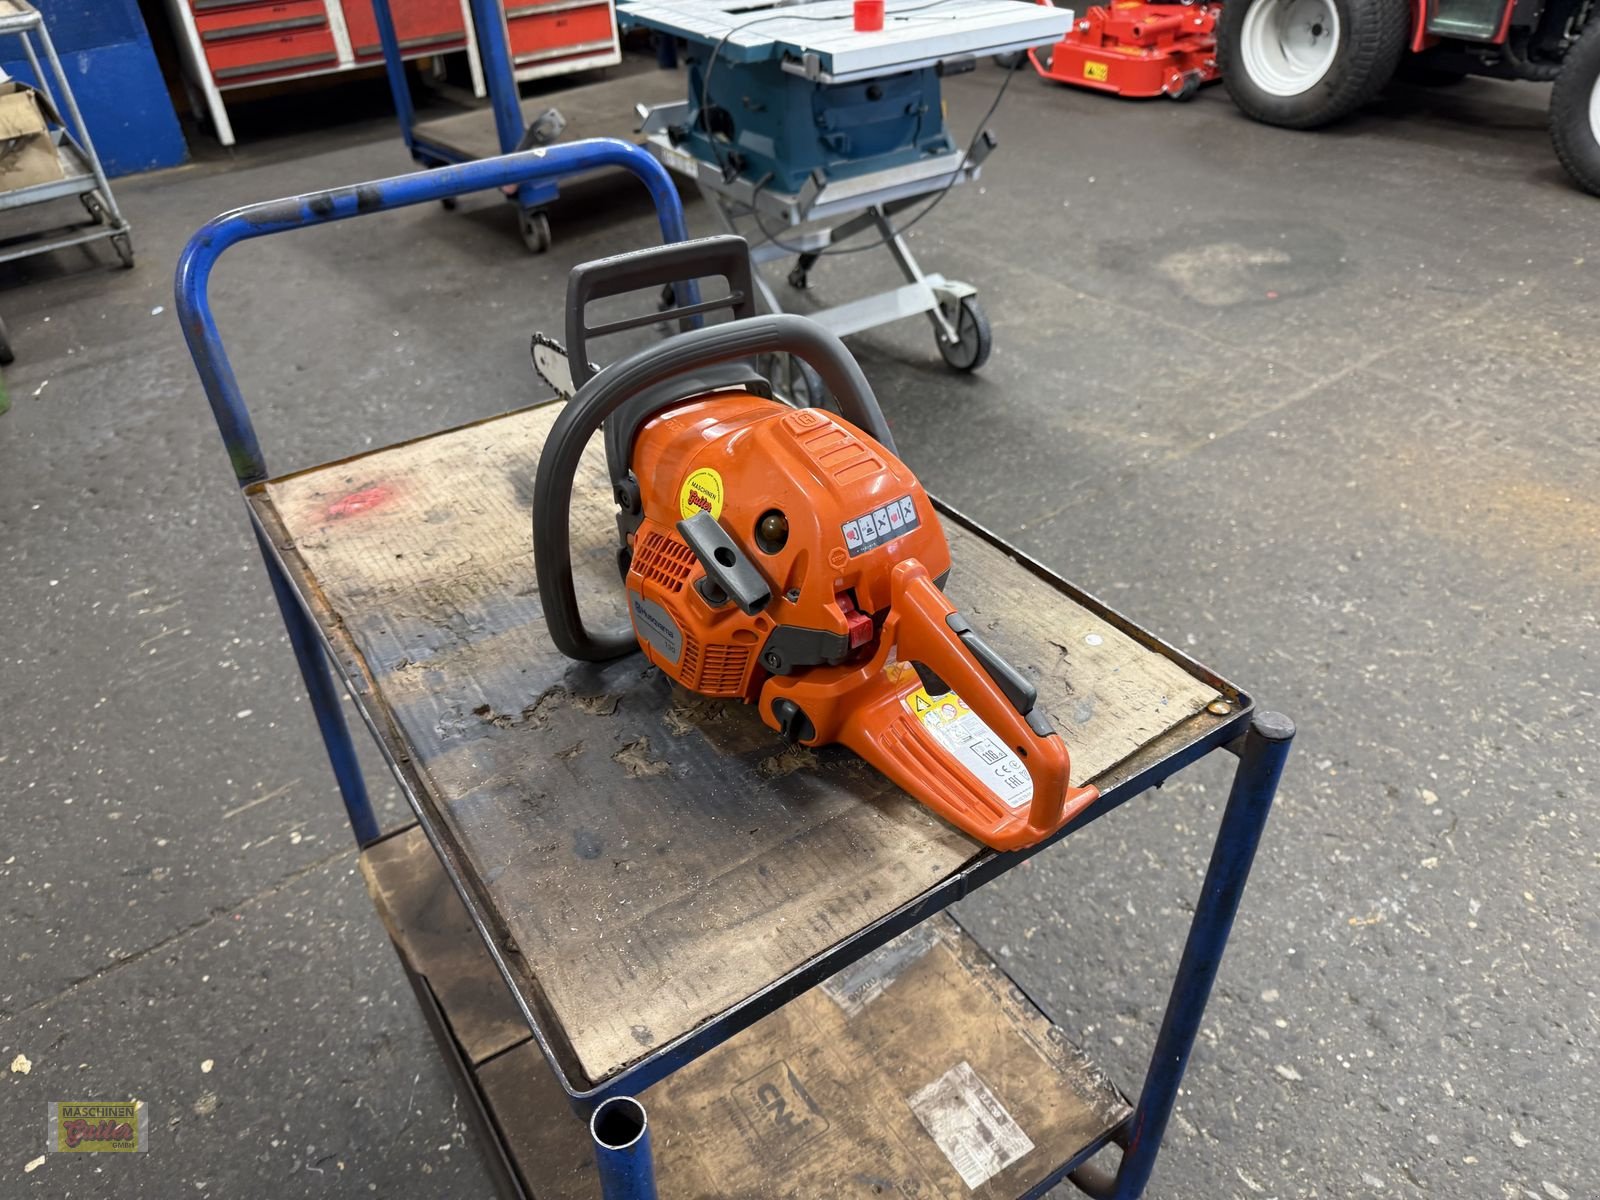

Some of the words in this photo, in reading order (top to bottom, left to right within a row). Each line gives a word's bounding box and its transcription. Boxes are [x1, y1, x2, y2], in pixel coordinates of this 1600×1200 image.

[691, 481, 717, 500] MASCHINEN
[641, 606, 674, 639] Husqvarna
[757, 1083, 810, 1137] CNH
